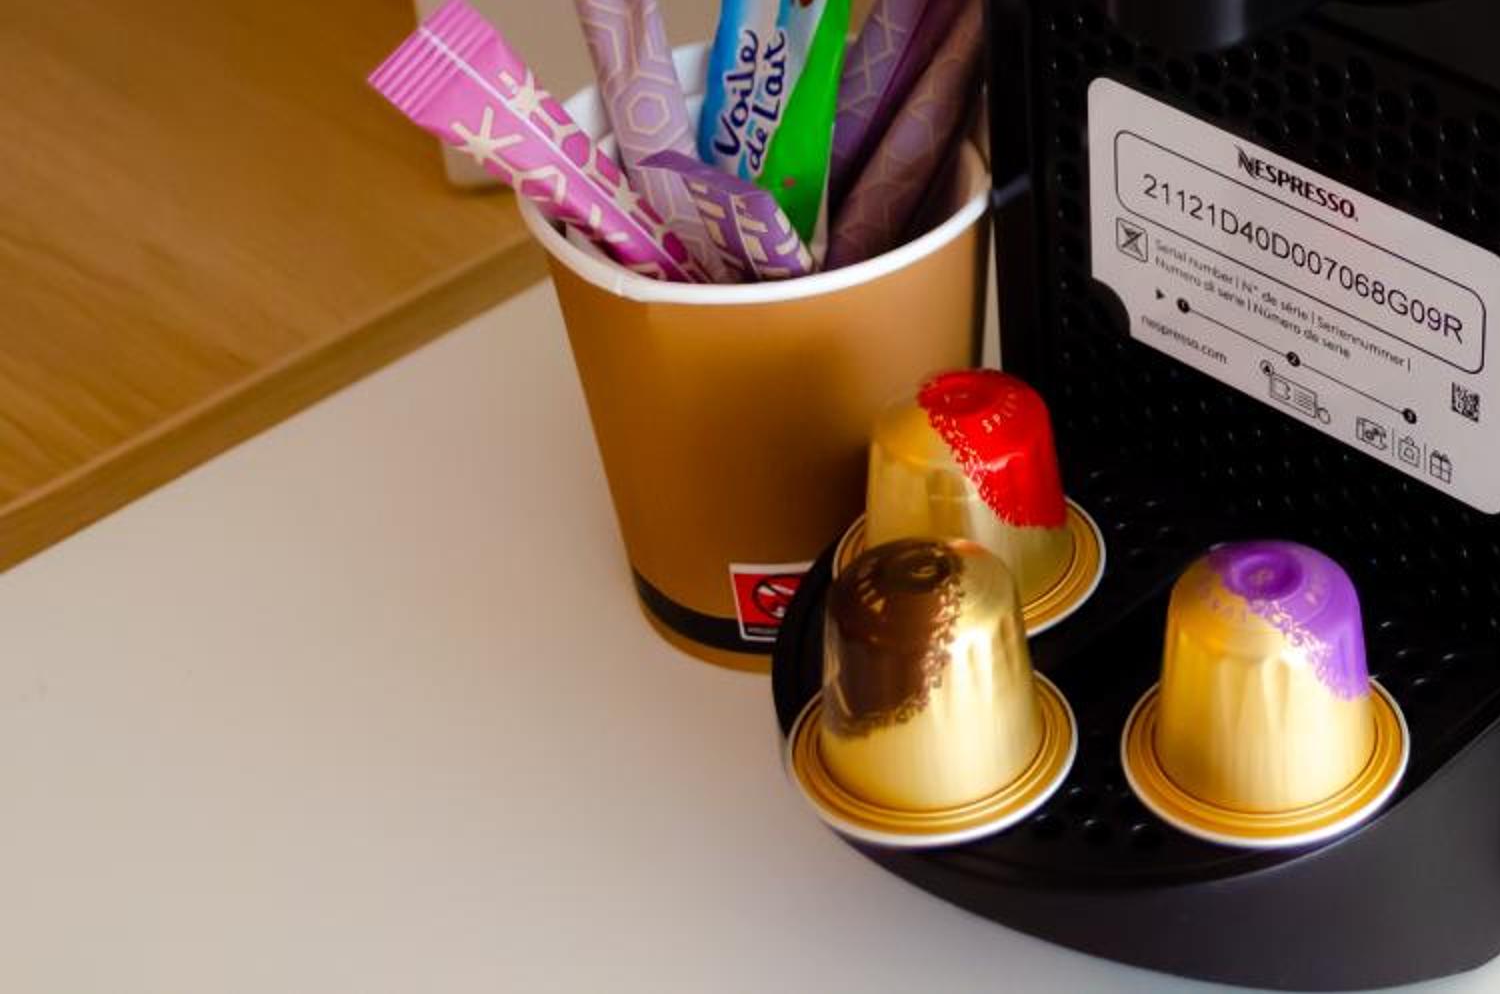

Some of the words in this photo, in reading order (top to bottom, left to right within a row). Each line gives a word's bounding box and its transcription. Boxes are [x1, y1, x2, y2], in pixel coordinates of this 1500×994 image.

[714, 29, 759, 156] Voile
[752, 31, 786, 122] Lait
[746, 127, 769, 172] de
[1142, 173, 1464, 345] 21121D40D007068G09R
[1155, 239, 1187, 263] Serial
[1188, 256, 1233, 284] number
[1262, 291, 1278, 306] de
[1303, 328, 1320, 344] de
